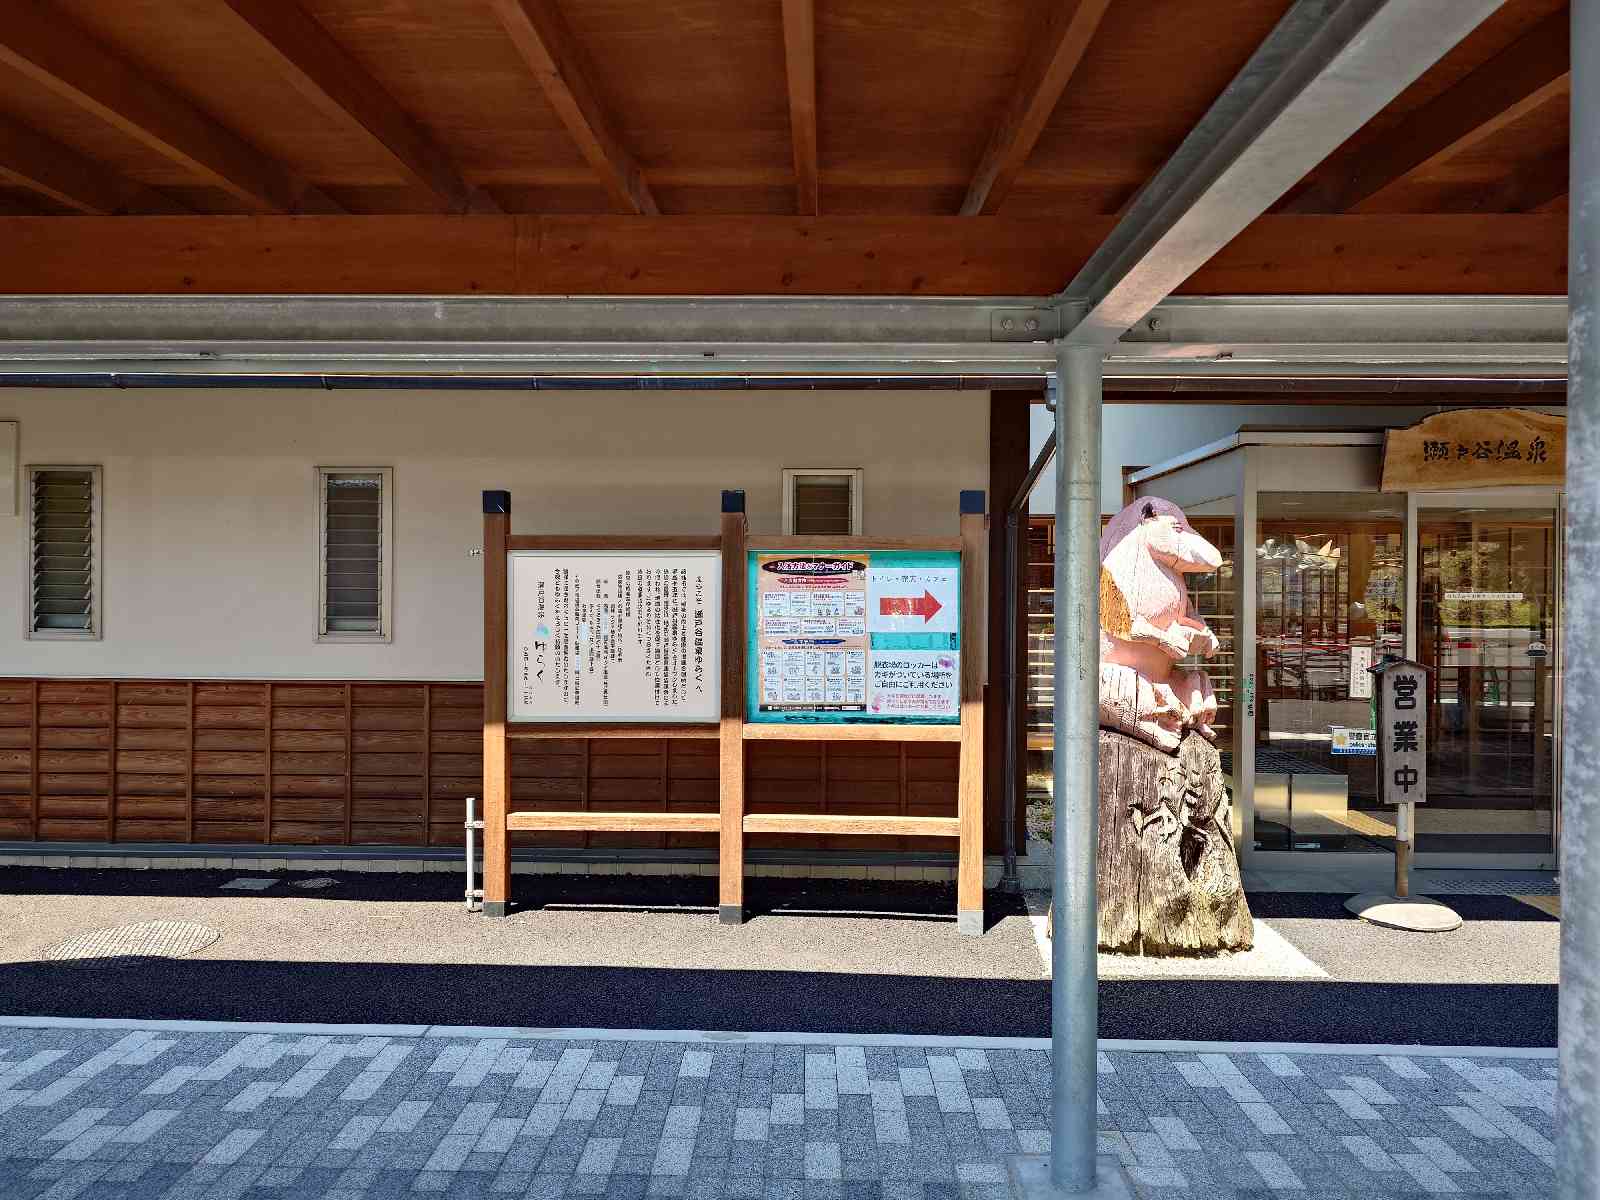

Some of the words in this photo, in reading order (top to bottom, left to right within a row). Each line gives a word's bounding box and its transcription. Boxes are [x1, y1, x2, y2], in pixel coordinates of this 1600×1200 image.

[1423, 435, 1549, 464] 瀬戸谷温泉
[1393, 674, 1418, 794] 営業中
